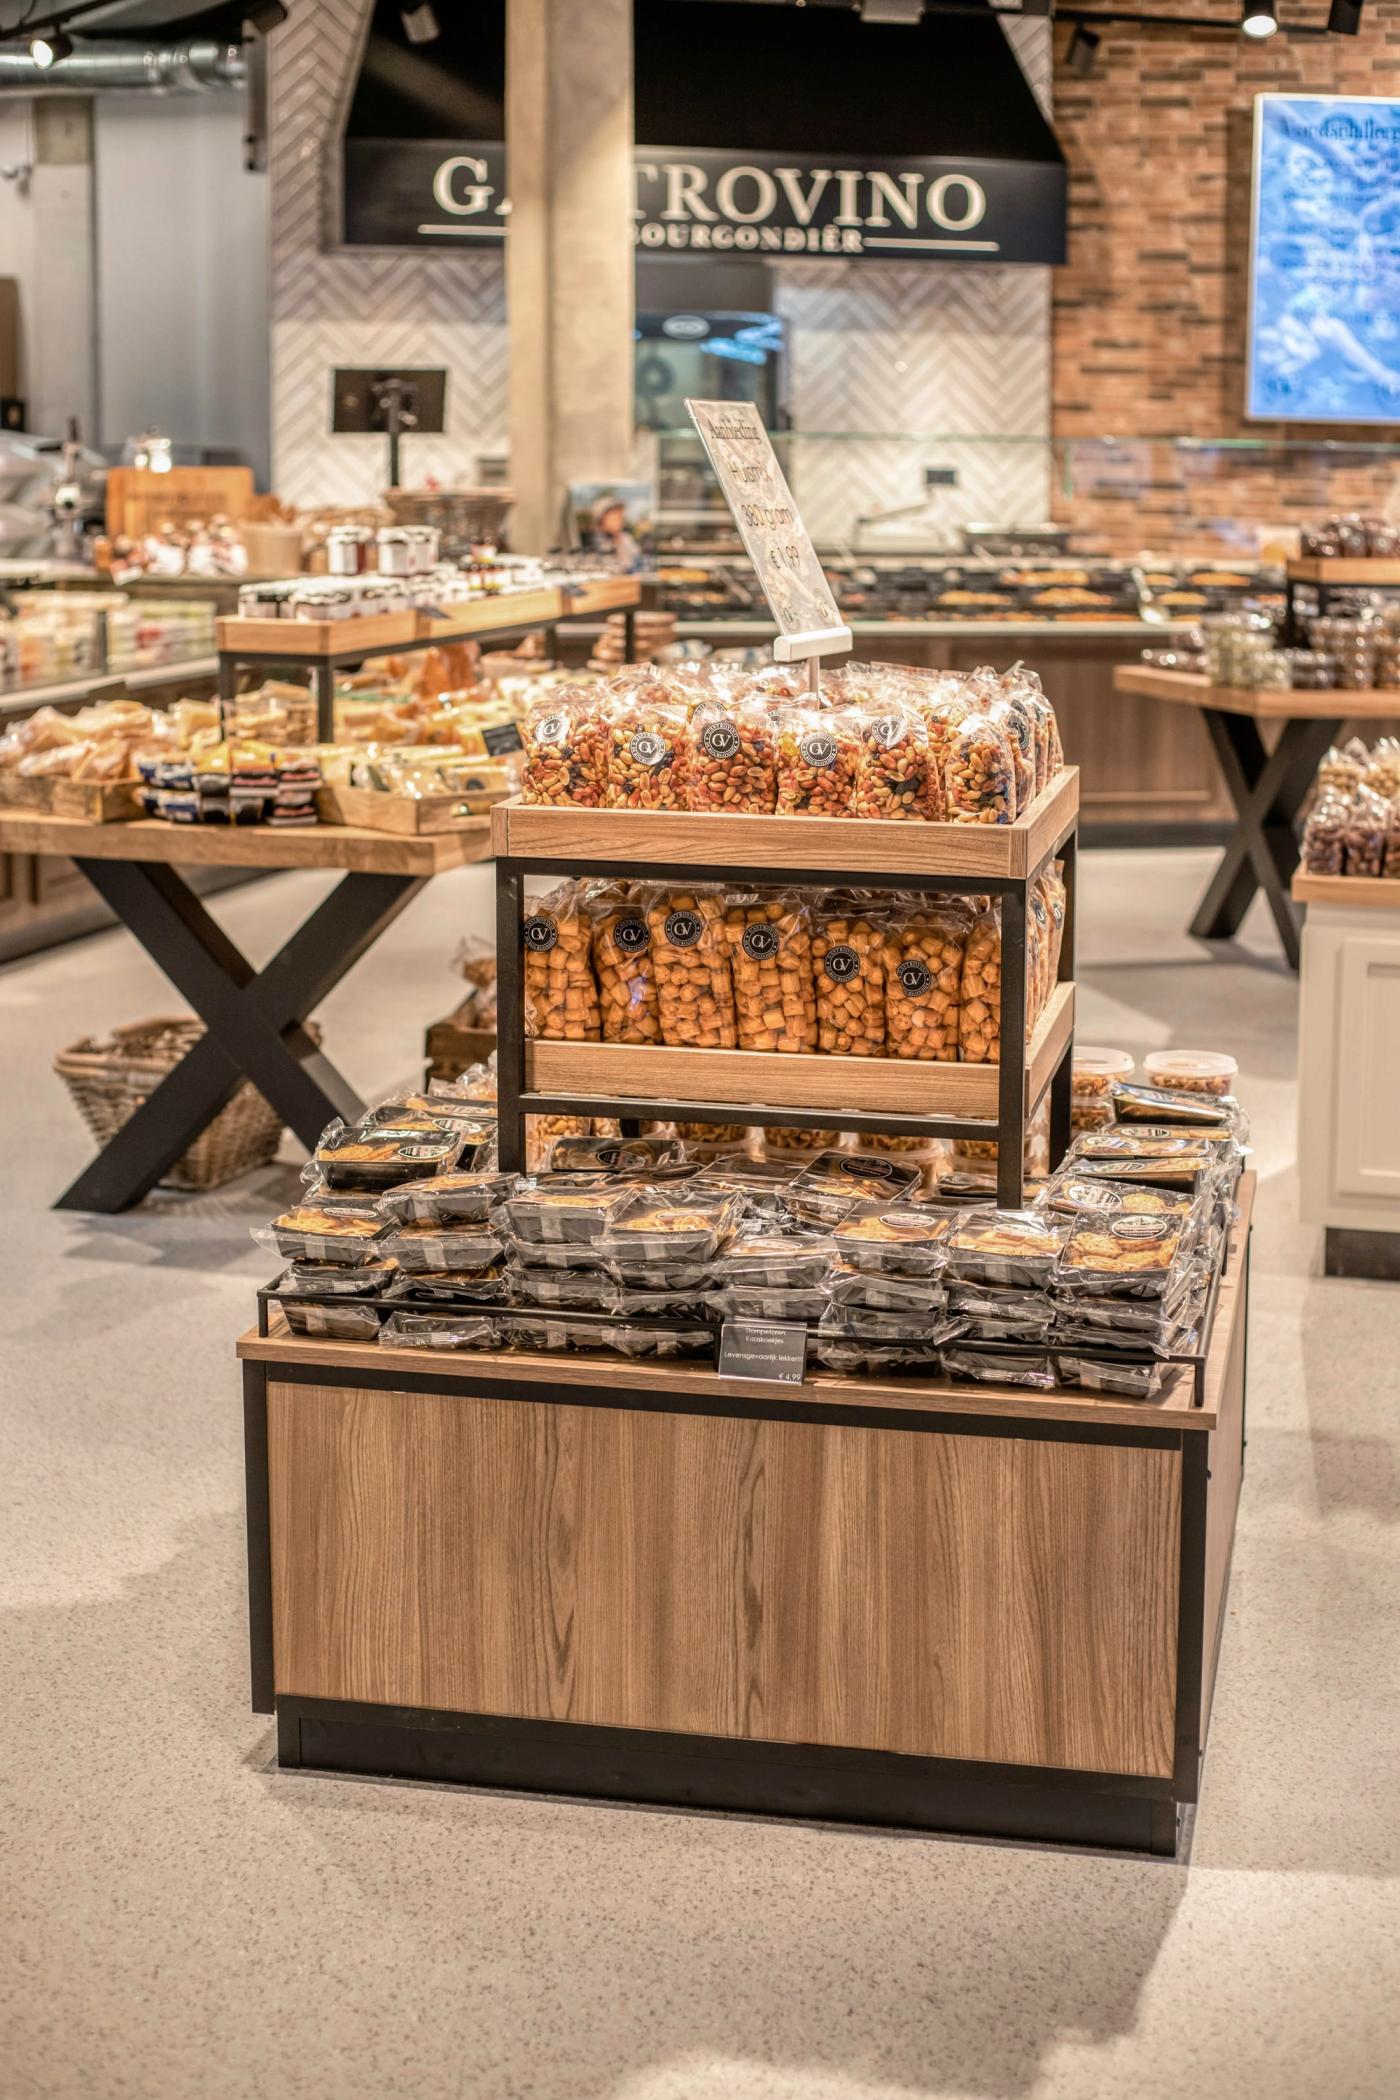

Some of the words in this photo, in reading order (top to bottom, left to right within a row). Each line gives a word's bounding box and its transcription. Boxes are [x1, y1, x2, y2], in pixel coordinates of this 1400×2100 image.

[433, 156, 986, 231] GTROVINO
[708, 419, 762, 445] Aanbieding
[741, 504, 764, 527] 380
[764, 507, 794, 531] gram
[745, 1335, 784, 1345] Kaaskoekjes
[724, 1351, 777, 1362] Levensgevaarlijk
